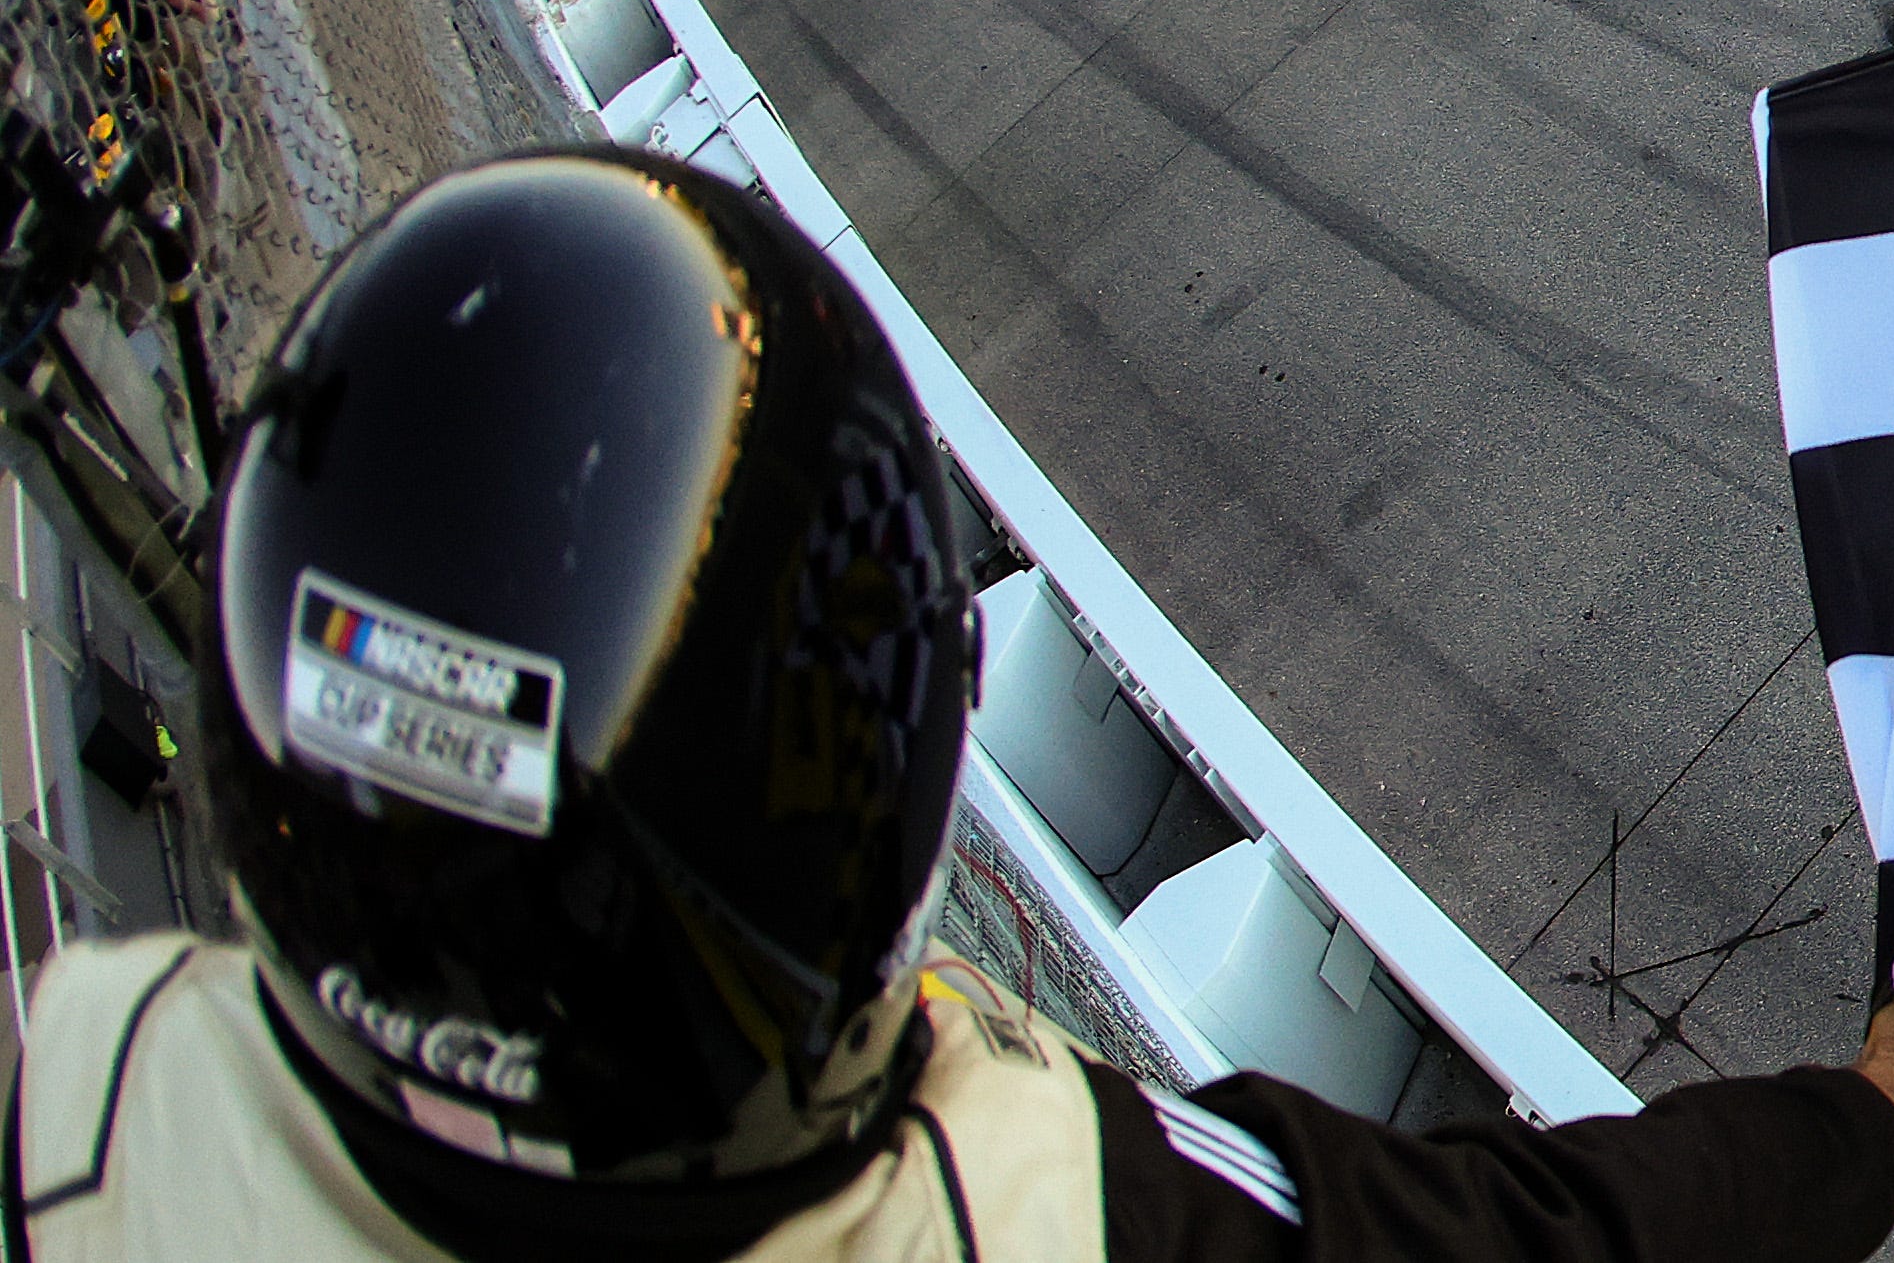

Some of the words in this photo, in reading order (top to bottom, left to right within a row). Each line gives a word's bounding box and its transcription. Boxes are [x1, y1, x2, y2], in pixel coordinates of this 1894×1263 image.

[364, 621, 518, 715] NASCAR
[317, 670, 384, 732] CUP
[386, 696, 514, 786] SERIES
